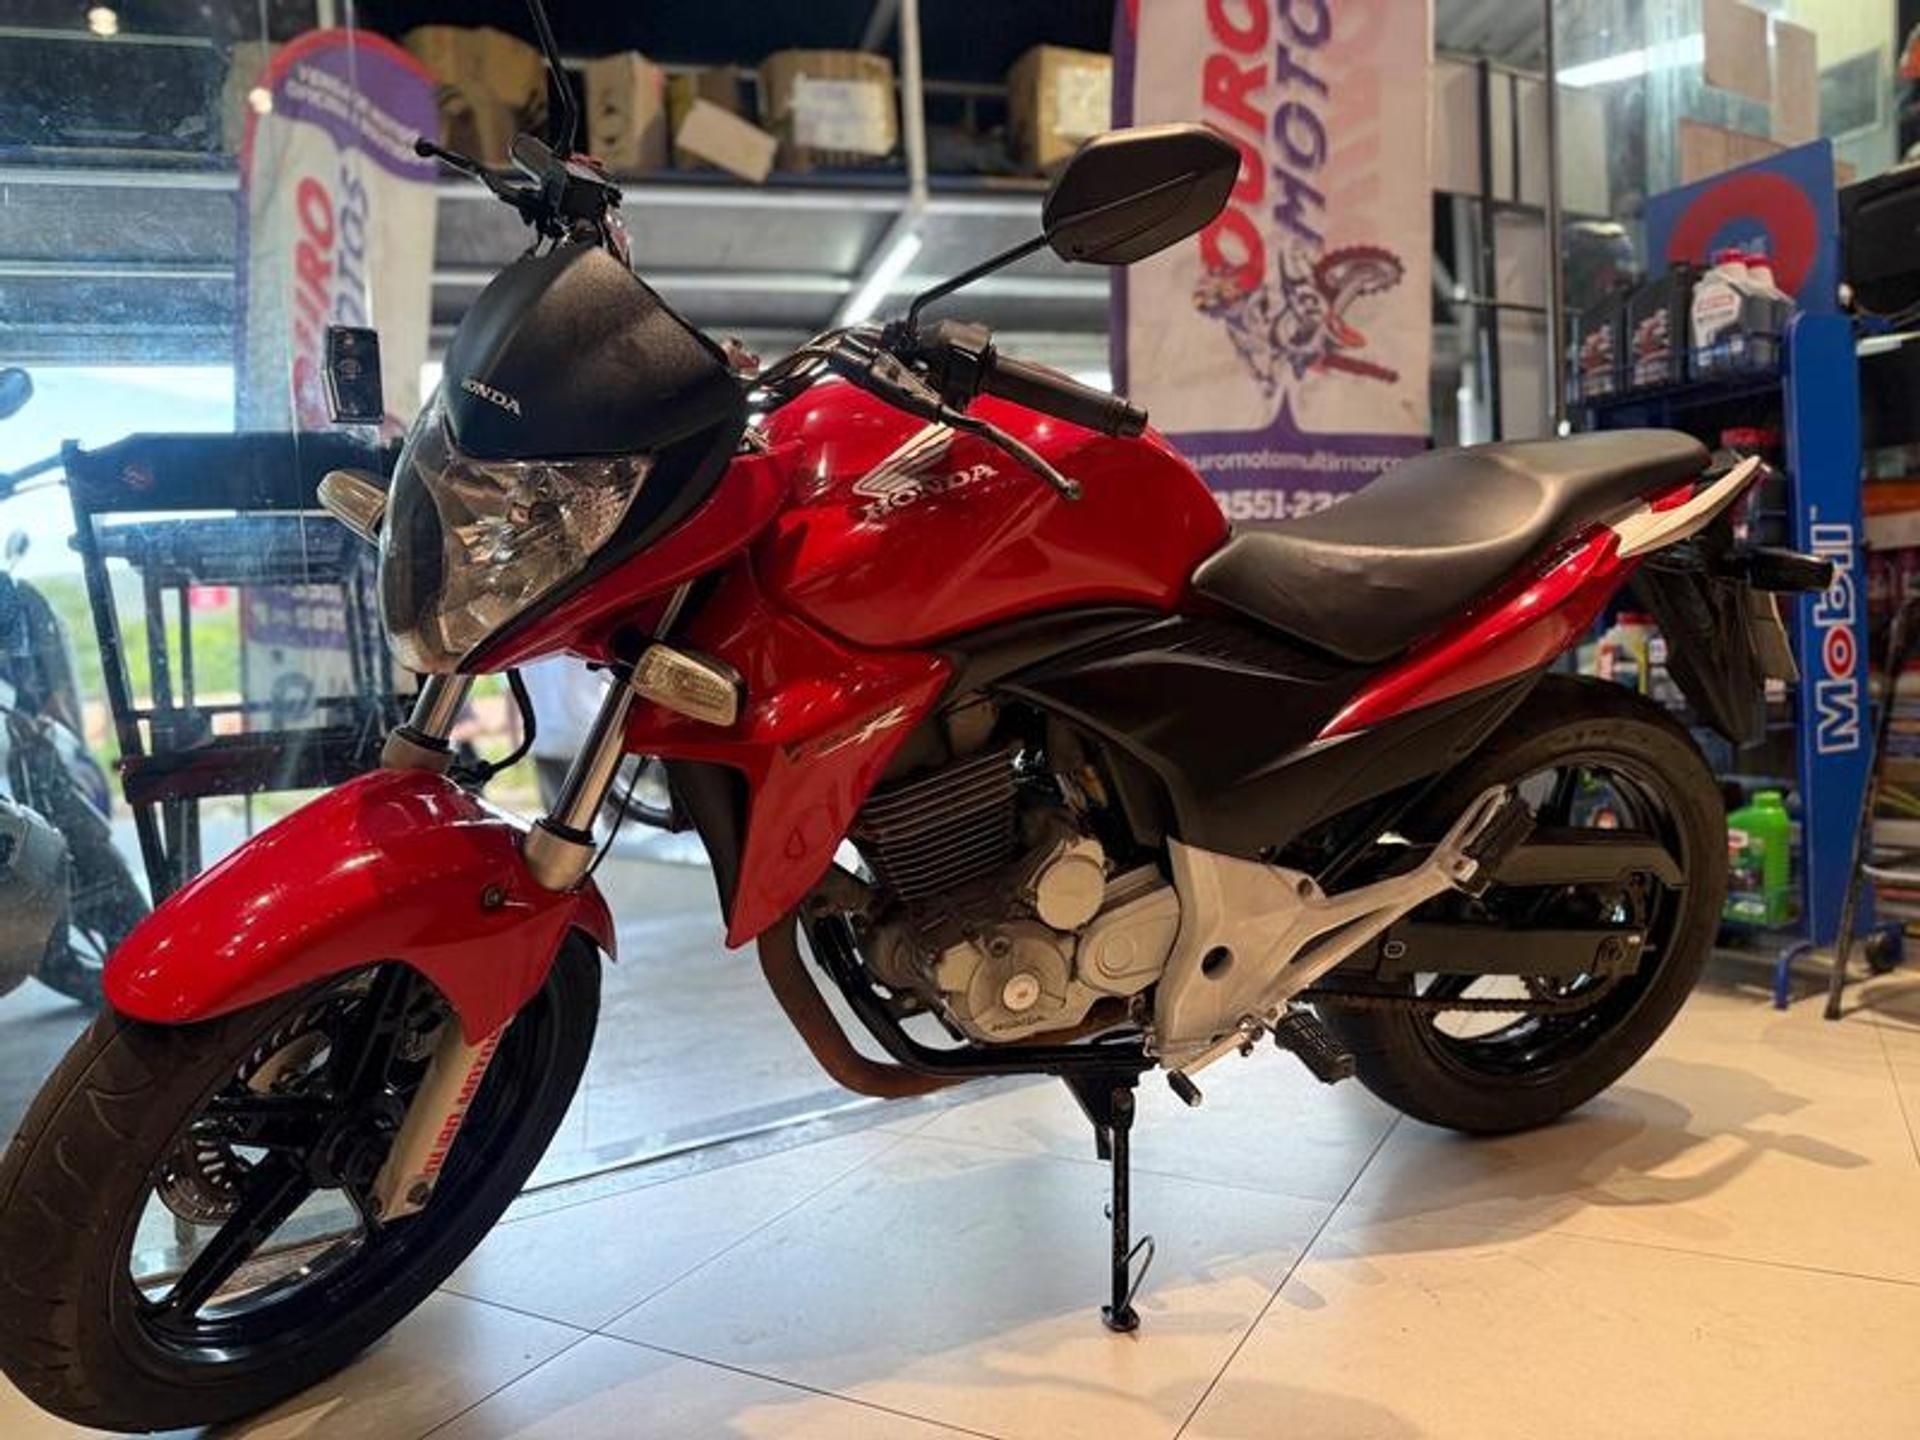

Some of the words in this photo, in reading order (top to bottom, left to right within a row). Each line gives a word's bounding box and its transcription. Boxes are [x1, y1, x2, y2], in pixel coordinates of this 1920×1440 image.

[861, 464, 999, 517] HONDA
[1213, 489, 1354, 520] 551-22
[1810, 523, 1859, 753] Mobil
